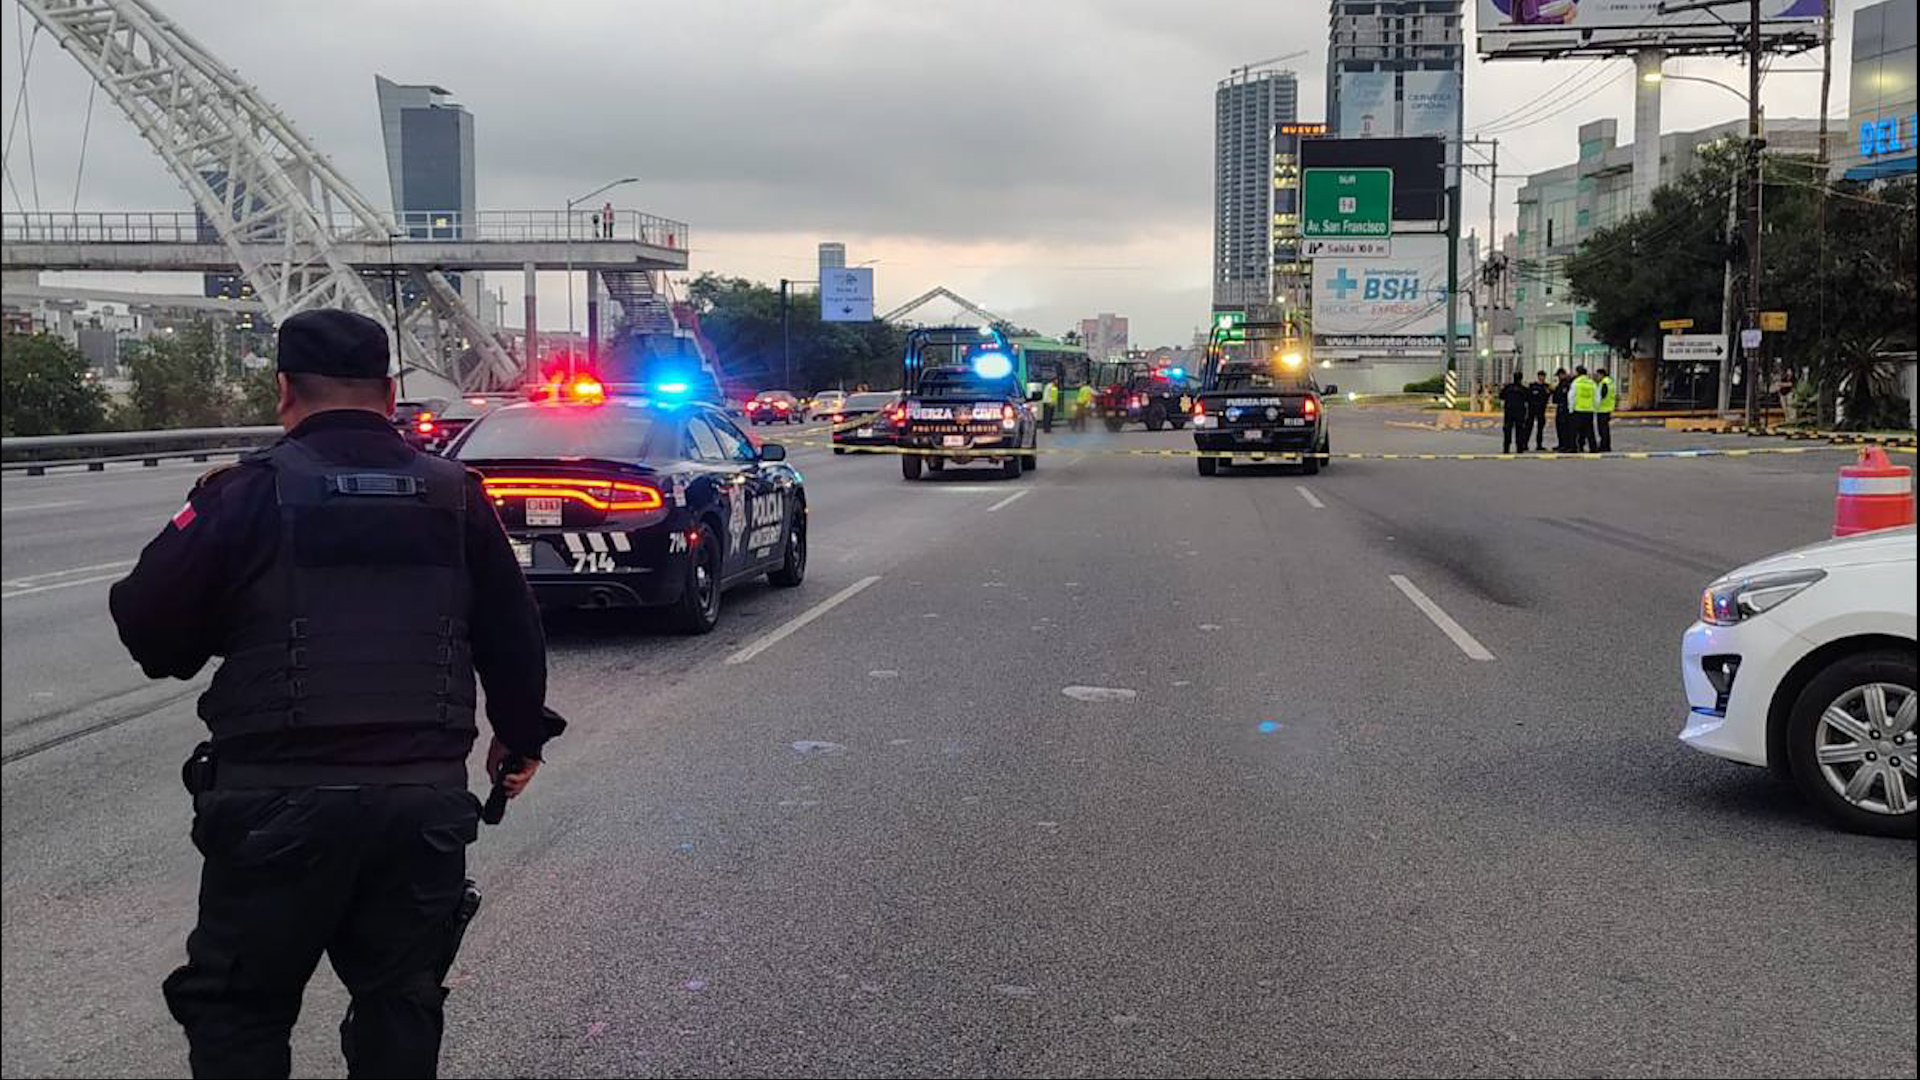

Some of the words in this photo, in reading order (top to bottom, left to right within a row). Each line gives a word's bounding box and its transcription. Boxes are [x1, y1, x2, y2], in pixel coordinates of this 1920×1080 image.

[1306, 220, 1320, 233] Av.
[1322, 220, 1341, 233] San
[1342, 219, 1386, 233] Francisco
[1363, 278, 1419, 300] BSH
[1325, 335, 1470, 347] www.laboratoriosbsh.m
[1226, 397, 1260, 406] FUERZA
[1261, 397, 1282, 406] CIVIL
[907, 407, 953, 420] FUERZA
[972, 407, 1004, 420] CIVIL
[571, 551, 616, 573] 714
